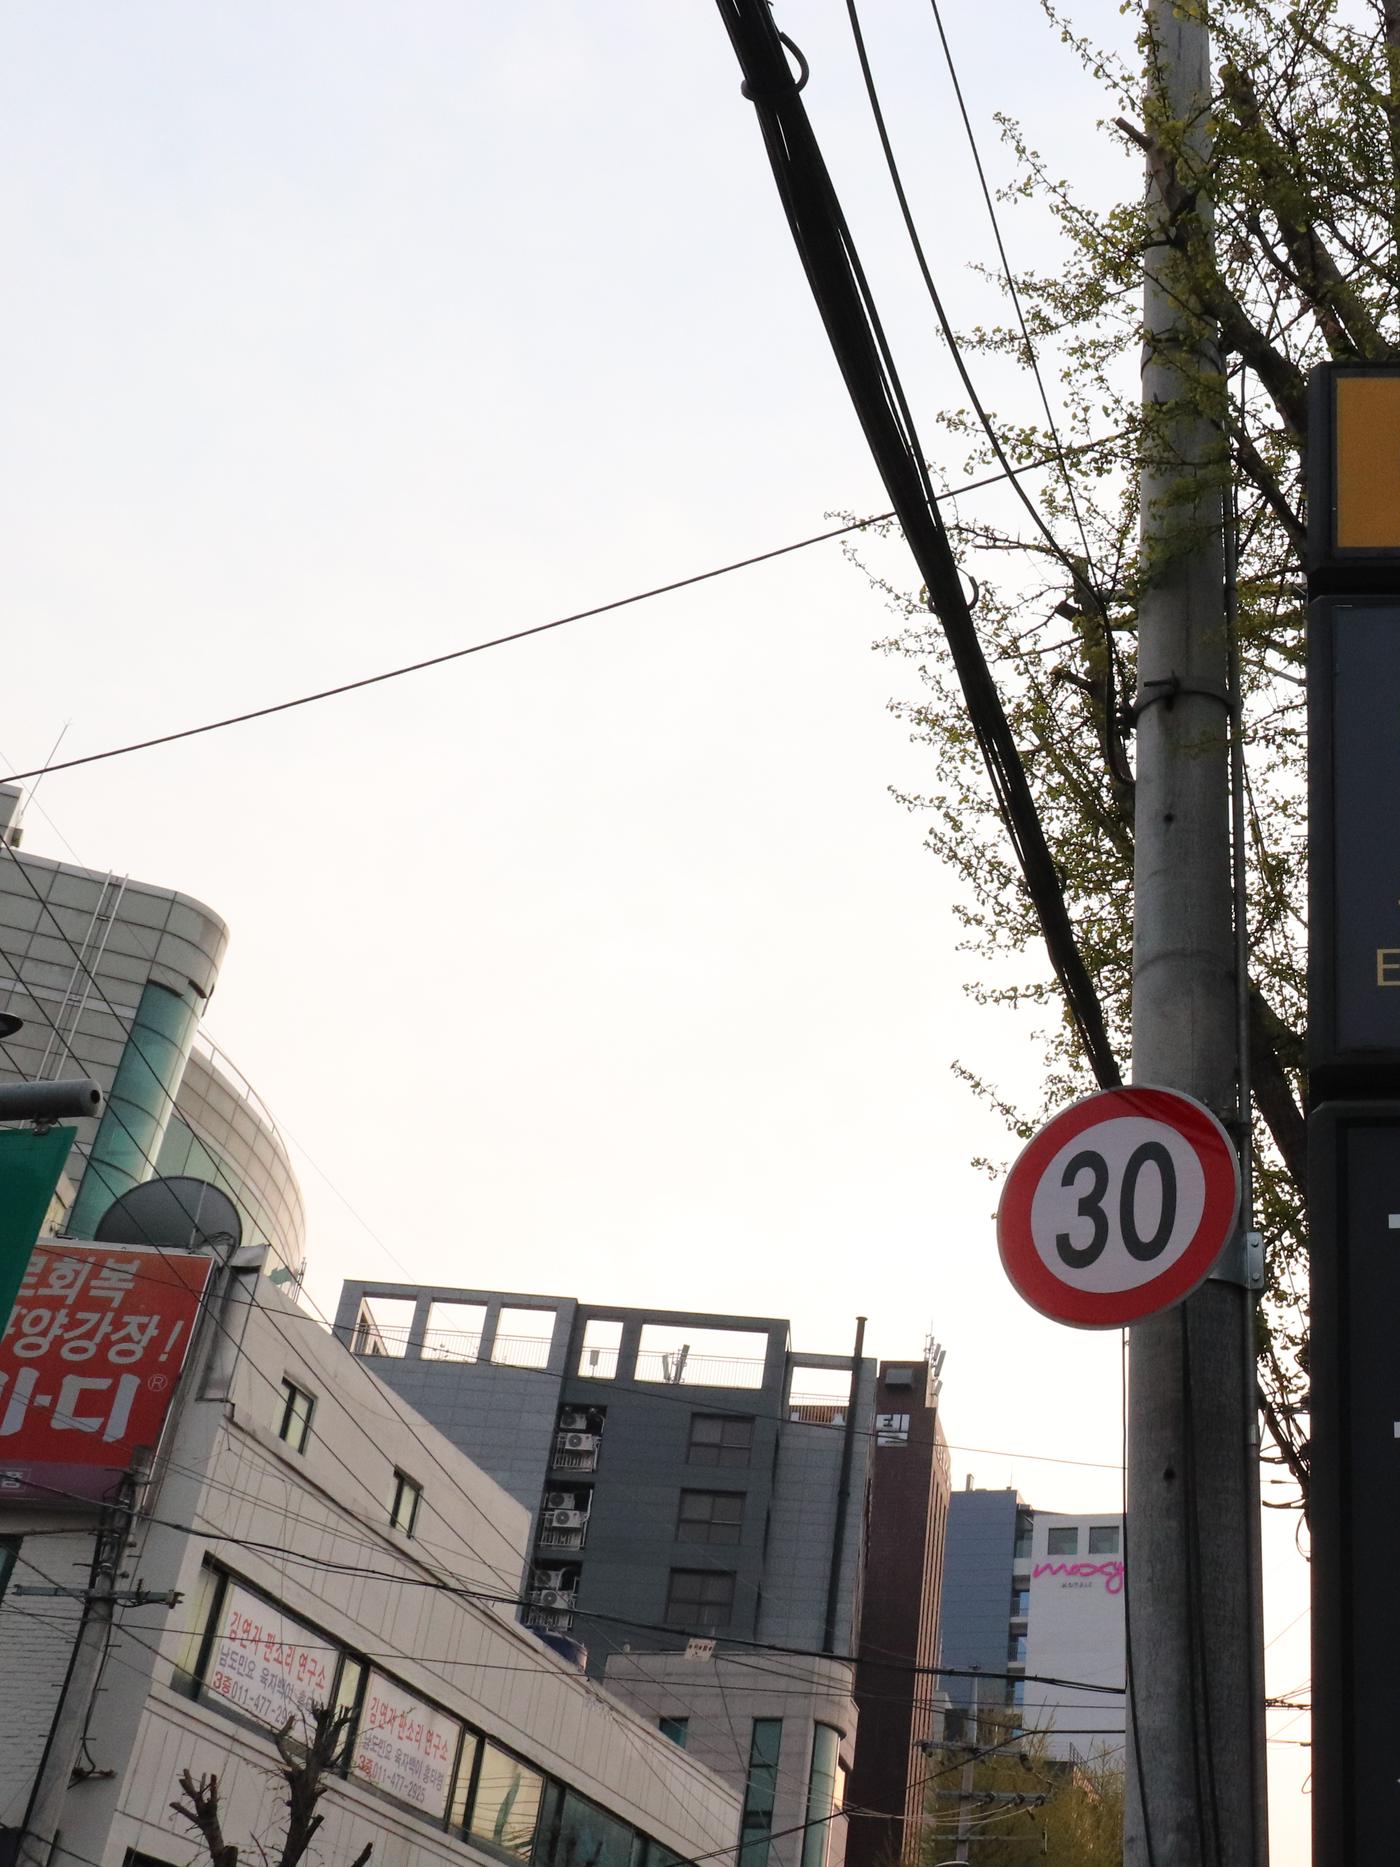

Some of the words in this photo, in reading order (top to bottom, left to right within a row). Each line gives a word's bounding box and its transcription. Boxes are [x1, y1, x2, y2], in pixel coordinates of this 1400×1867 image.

[1056, 1141, 1177, 1269] 30
[218, 1644, 256, 1680] 남도민요
[263, 1632, 296, 1675] 판소리
[297, 1652, 326, 1691] 연구소
[424, 1728, 448, 1761] 연구소
